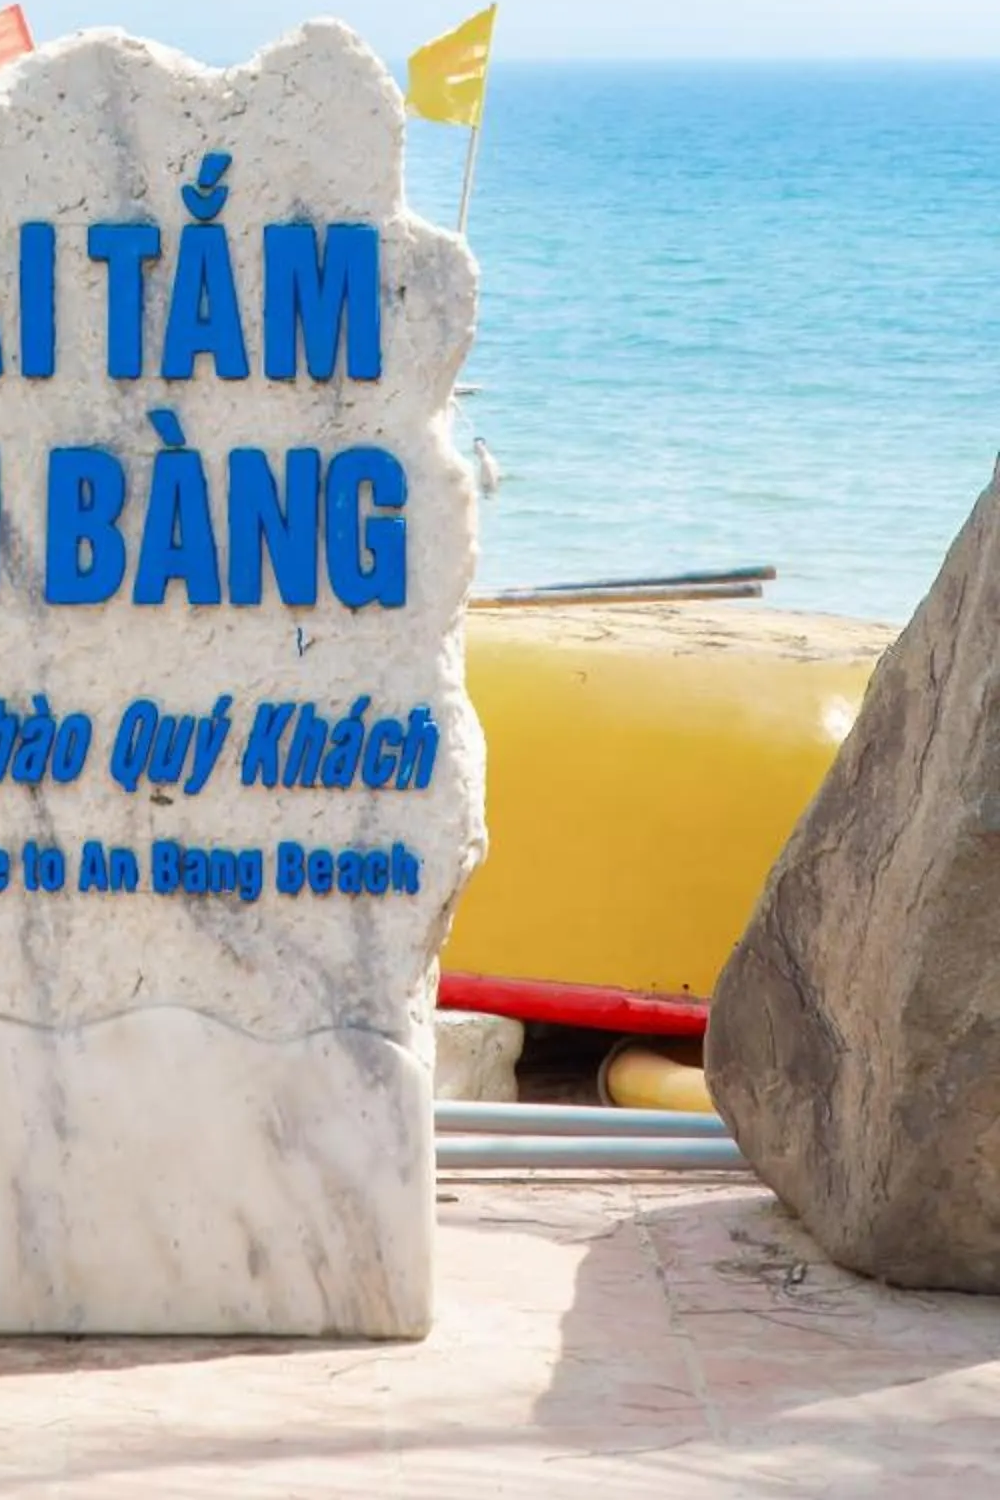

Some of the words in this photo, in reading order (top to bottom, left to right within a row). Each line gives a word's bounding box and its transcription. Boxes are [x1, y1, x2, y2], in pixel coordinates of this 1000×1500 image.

[86, 151, 383, 382] TẮM
[44, 406, 409, 609] BÀNG
[109, 696, 234, 796] Quý
[240, 694, 441, 790] Khách
[22, 839, 67, 892] to
[77, 839, 140, 893] An
[151, 839, 264, 902] Bang
[275, 839, 421, 896] Beach
